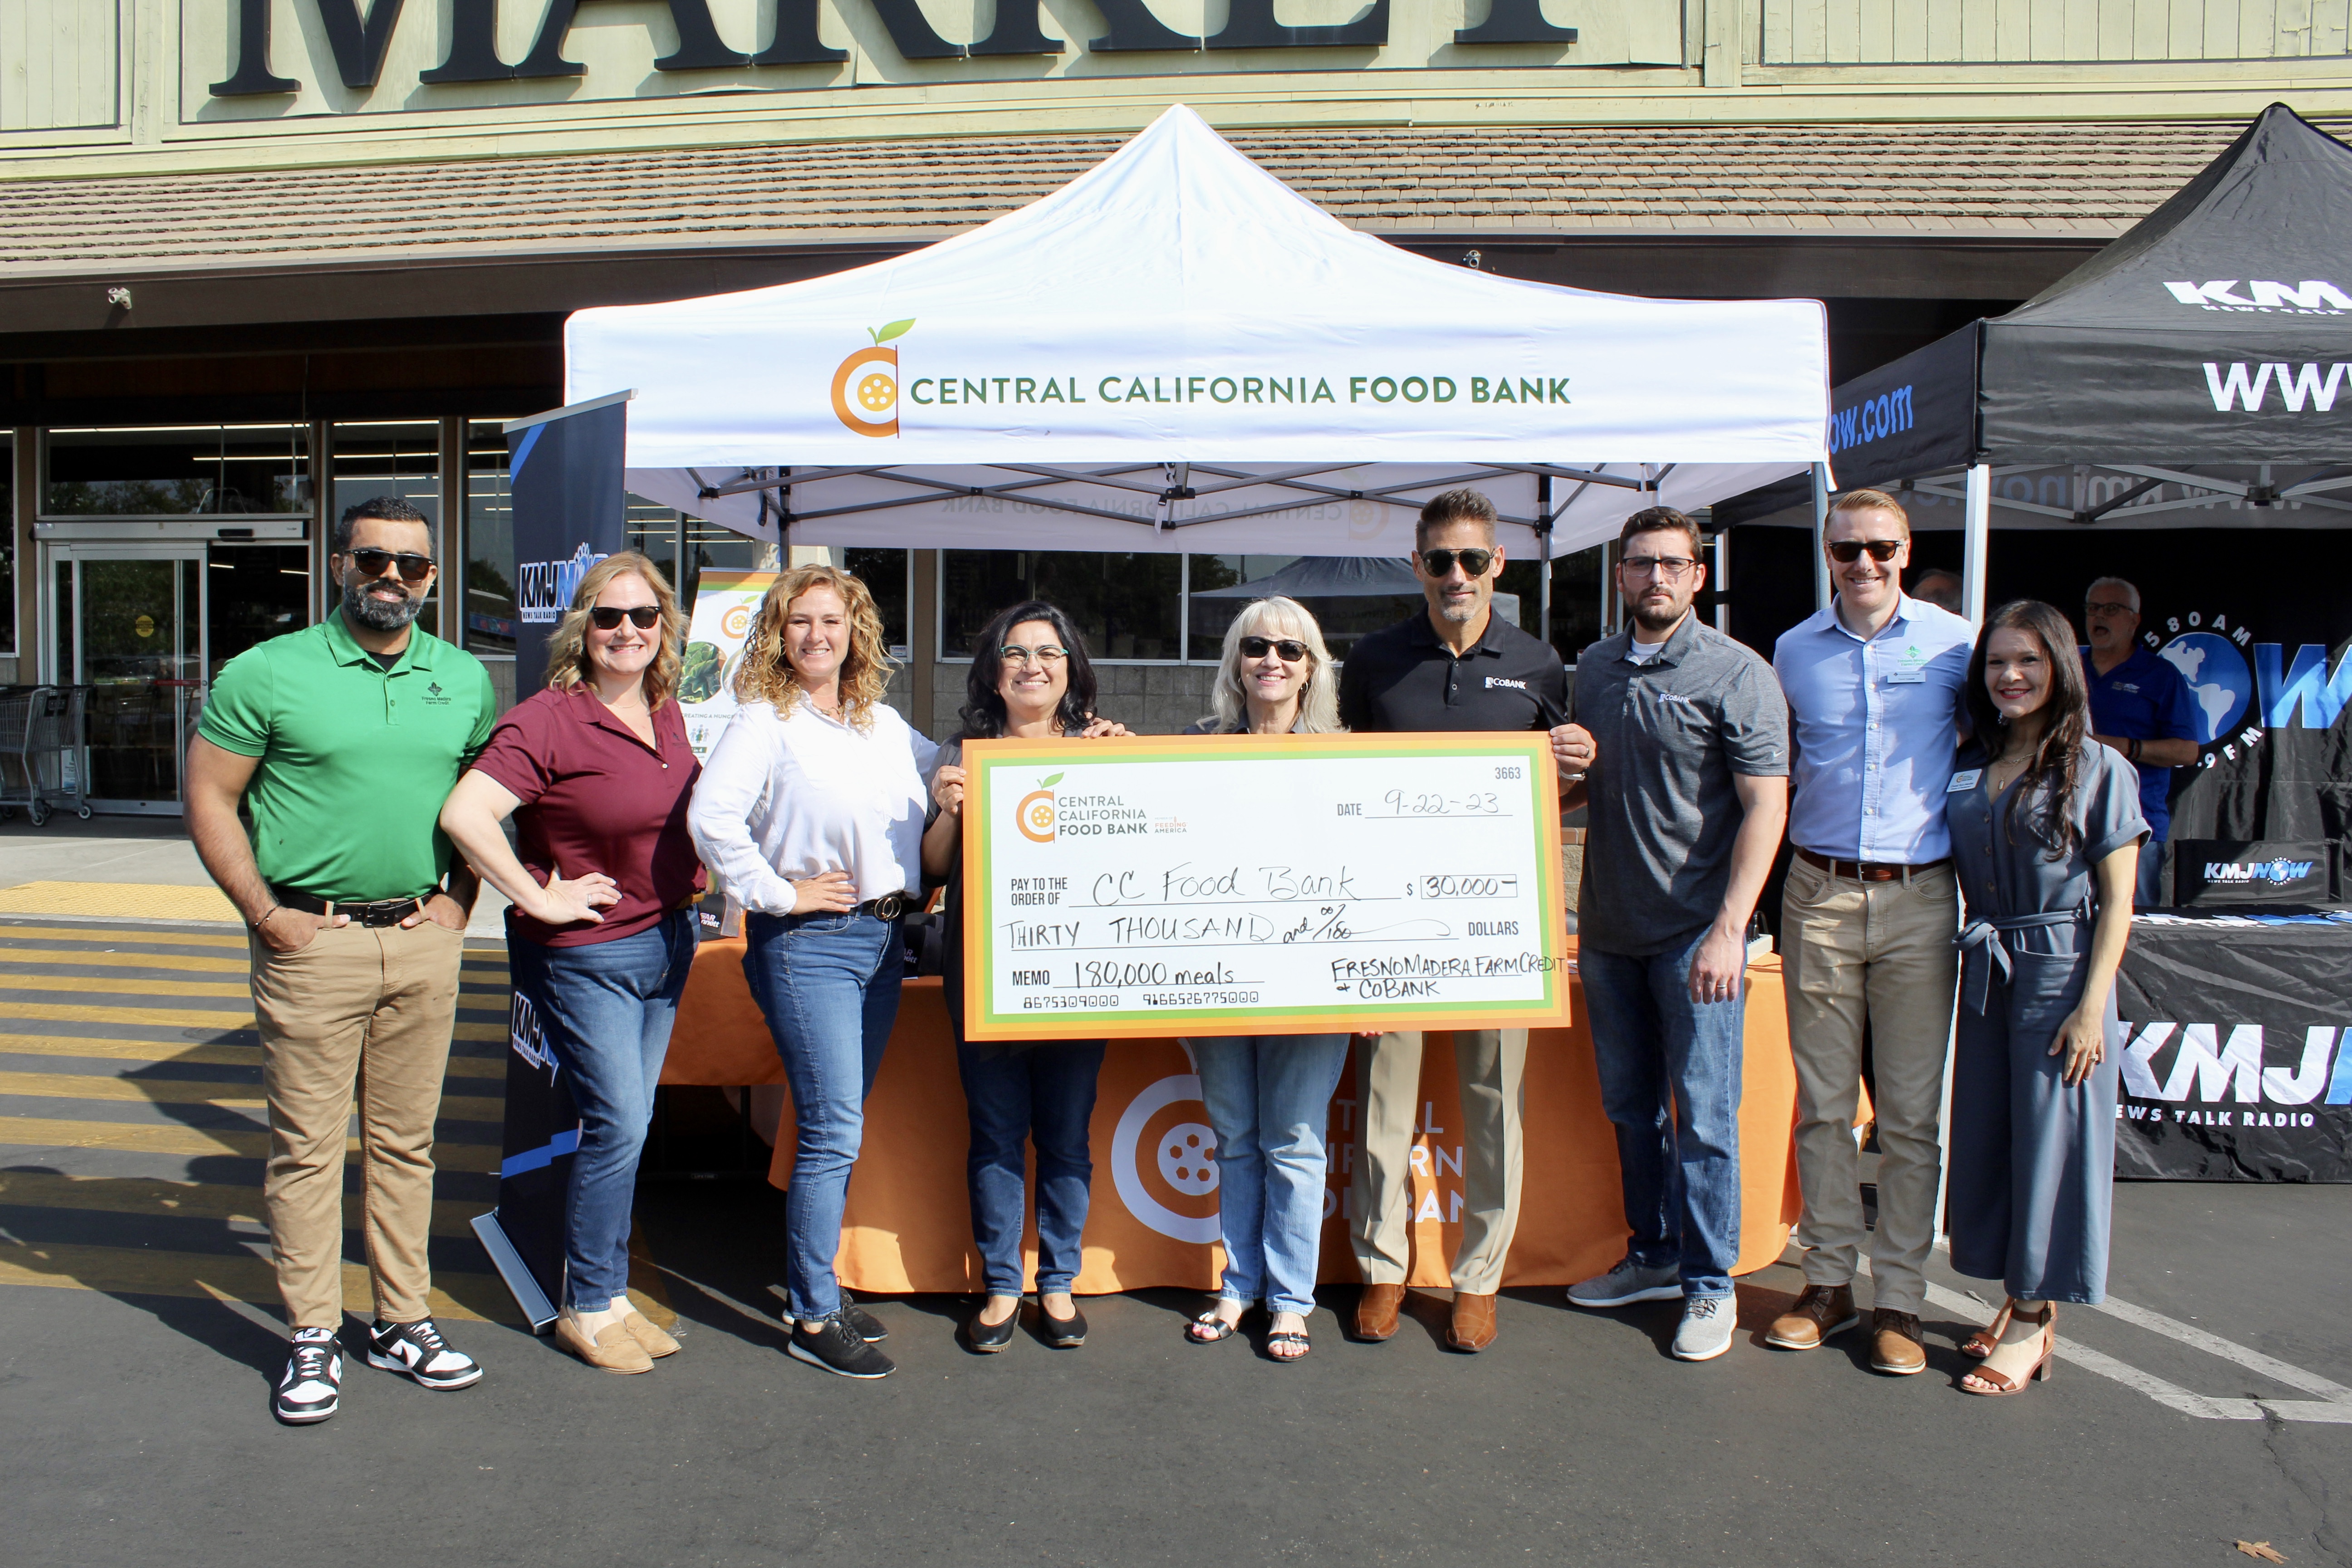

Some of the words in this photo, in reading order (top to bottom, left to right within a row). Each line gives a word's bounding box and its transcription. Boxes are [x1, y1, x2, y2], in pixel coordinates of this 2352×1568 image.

[911, 377, 1086, 405] CENTRAL
[1099, 376, 1335, 404] CALIFORNIA
[1350, 376, 1457, 403] FOOD
[1471, 377, 1571, 404] BANK
[1495, 767, 1521, 779] 3663
[1058, 795, 1124, 808] CENTRAL
[1058, 808, 1147, 821] CALIFORNIA
[1337, 803, 1362, 816] DATE
[1059, 824, 1102, 836] FOOD
[1107, 823, 1148, 835] BANK
[1011, 878, 1029, 891] PAY
[1032, 878, 1045, 890] TO
[1048, 877, 1068, 890] THE
[1093, 870, 1145, 906] CC
[1163, 862, 1245, 902] Food
[1259, 866, 1361, 901] Bank
[1406, 883, 1413, 896] $
[1011, 892, 1045, 906] ORDER
[1048, 892, 1060, 905] OF
[999, 921, 1080, 948] THIRTY
[1109, 913, 1274, 943] THOUSAND
[1283, 916, 1314, 944] and
[1468, 921, 1519, 936] DOLLARS
[1012, 970, 1050, 985] MEMO
[1075, 961, 1167, 988] 180,000
[1175, 961, 1234, 985] meals
[2115, 1104, 2162, 1122] EWS
[2175, 1110, 2232, 1126] TALK
[2242, 1112, 2314, 1127] RADIO
